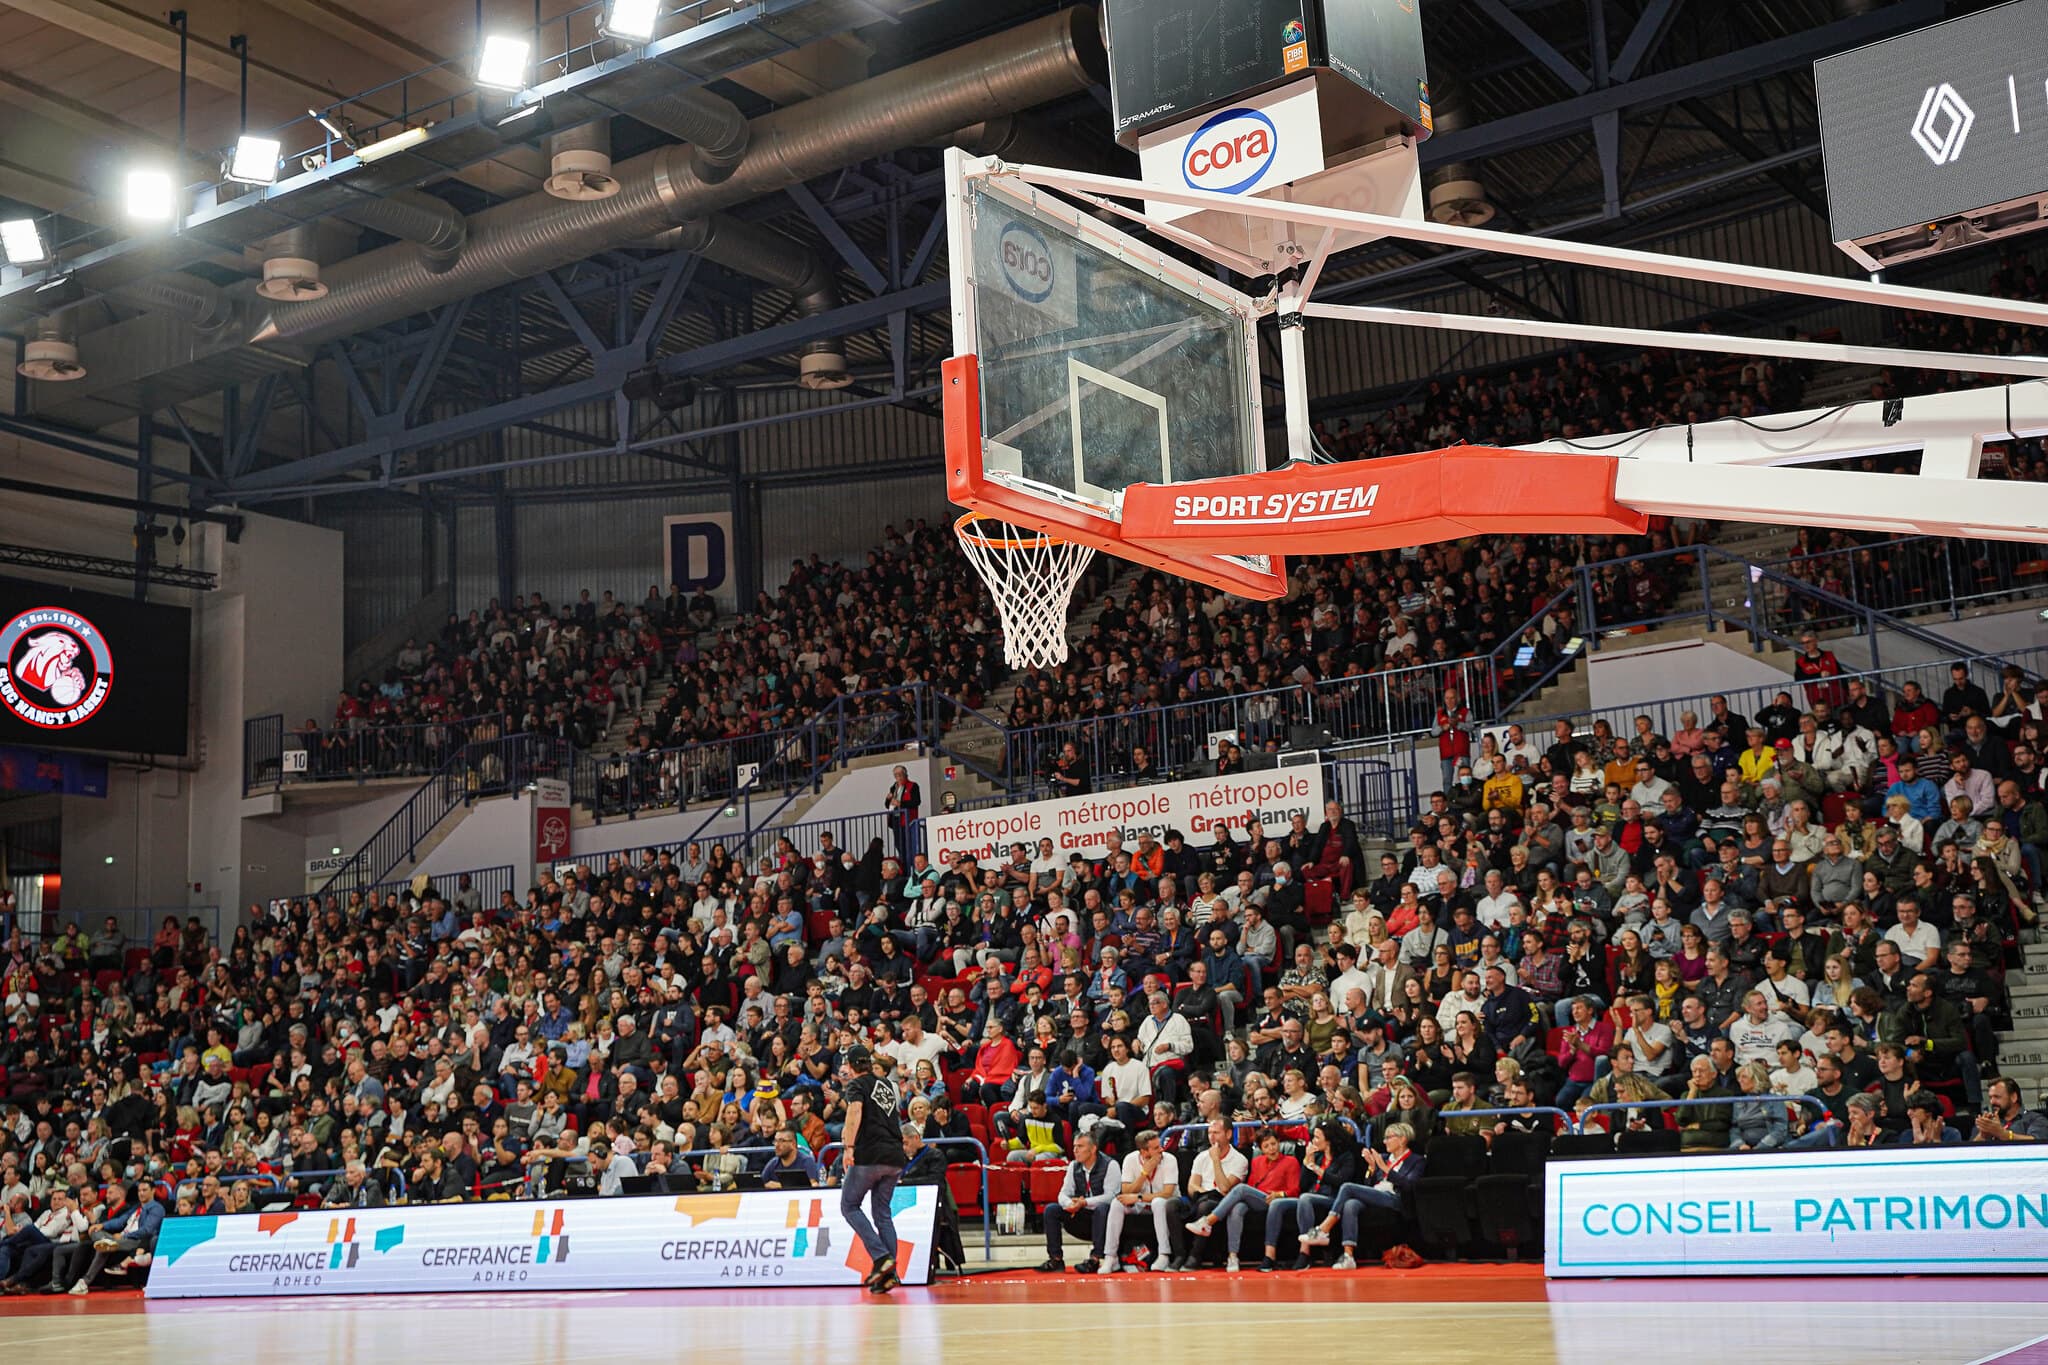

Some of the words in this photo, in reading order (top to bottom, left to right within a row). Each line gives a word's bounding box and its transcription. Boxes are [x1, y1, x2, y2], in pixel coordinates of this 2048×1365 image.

[1287, 47, 1303, 60] FIBA
[1329, 54, 1362, 80] STRAMATEL
[1120, 102, 1175, 128] STRAMATEL
[1188, 129, 1270, 177] cora
[1174, 496, 1263, 517] SPORT
[1264, 485, 1379, 522] SYSTEM
[670, 522, 726, 593] D
[14, 699, 67, 725] NANCY
[67, 677, 109, 722] BASKET
[1210, 736, 1217, 746] D
[293, 753, 306, 768] 10
[738, 768, 745, 777] D
[1189, 775, 1309, 810] métropole
[1058, 793, 1170, 827] métropole
[937, 811, 1041, 844] métropole
[310, 854, 369, 871] BRASSEE
[1583, 1200, 1772, 1237] CONSEIL
[1795, 1193, 2048, 1232] PATRIMON
[422, 1246, 532, 1266] CERFRANCE
[661, 1238, 788, 1260] CERFRANCE
[229, 1252, 327, 1272] CERFRANCE
[720, 1265, 784, 1277] ADHEO
[273, 1275, 322, 1287] ADHEO
[472, 1270, 528, 1282] ADHEO
